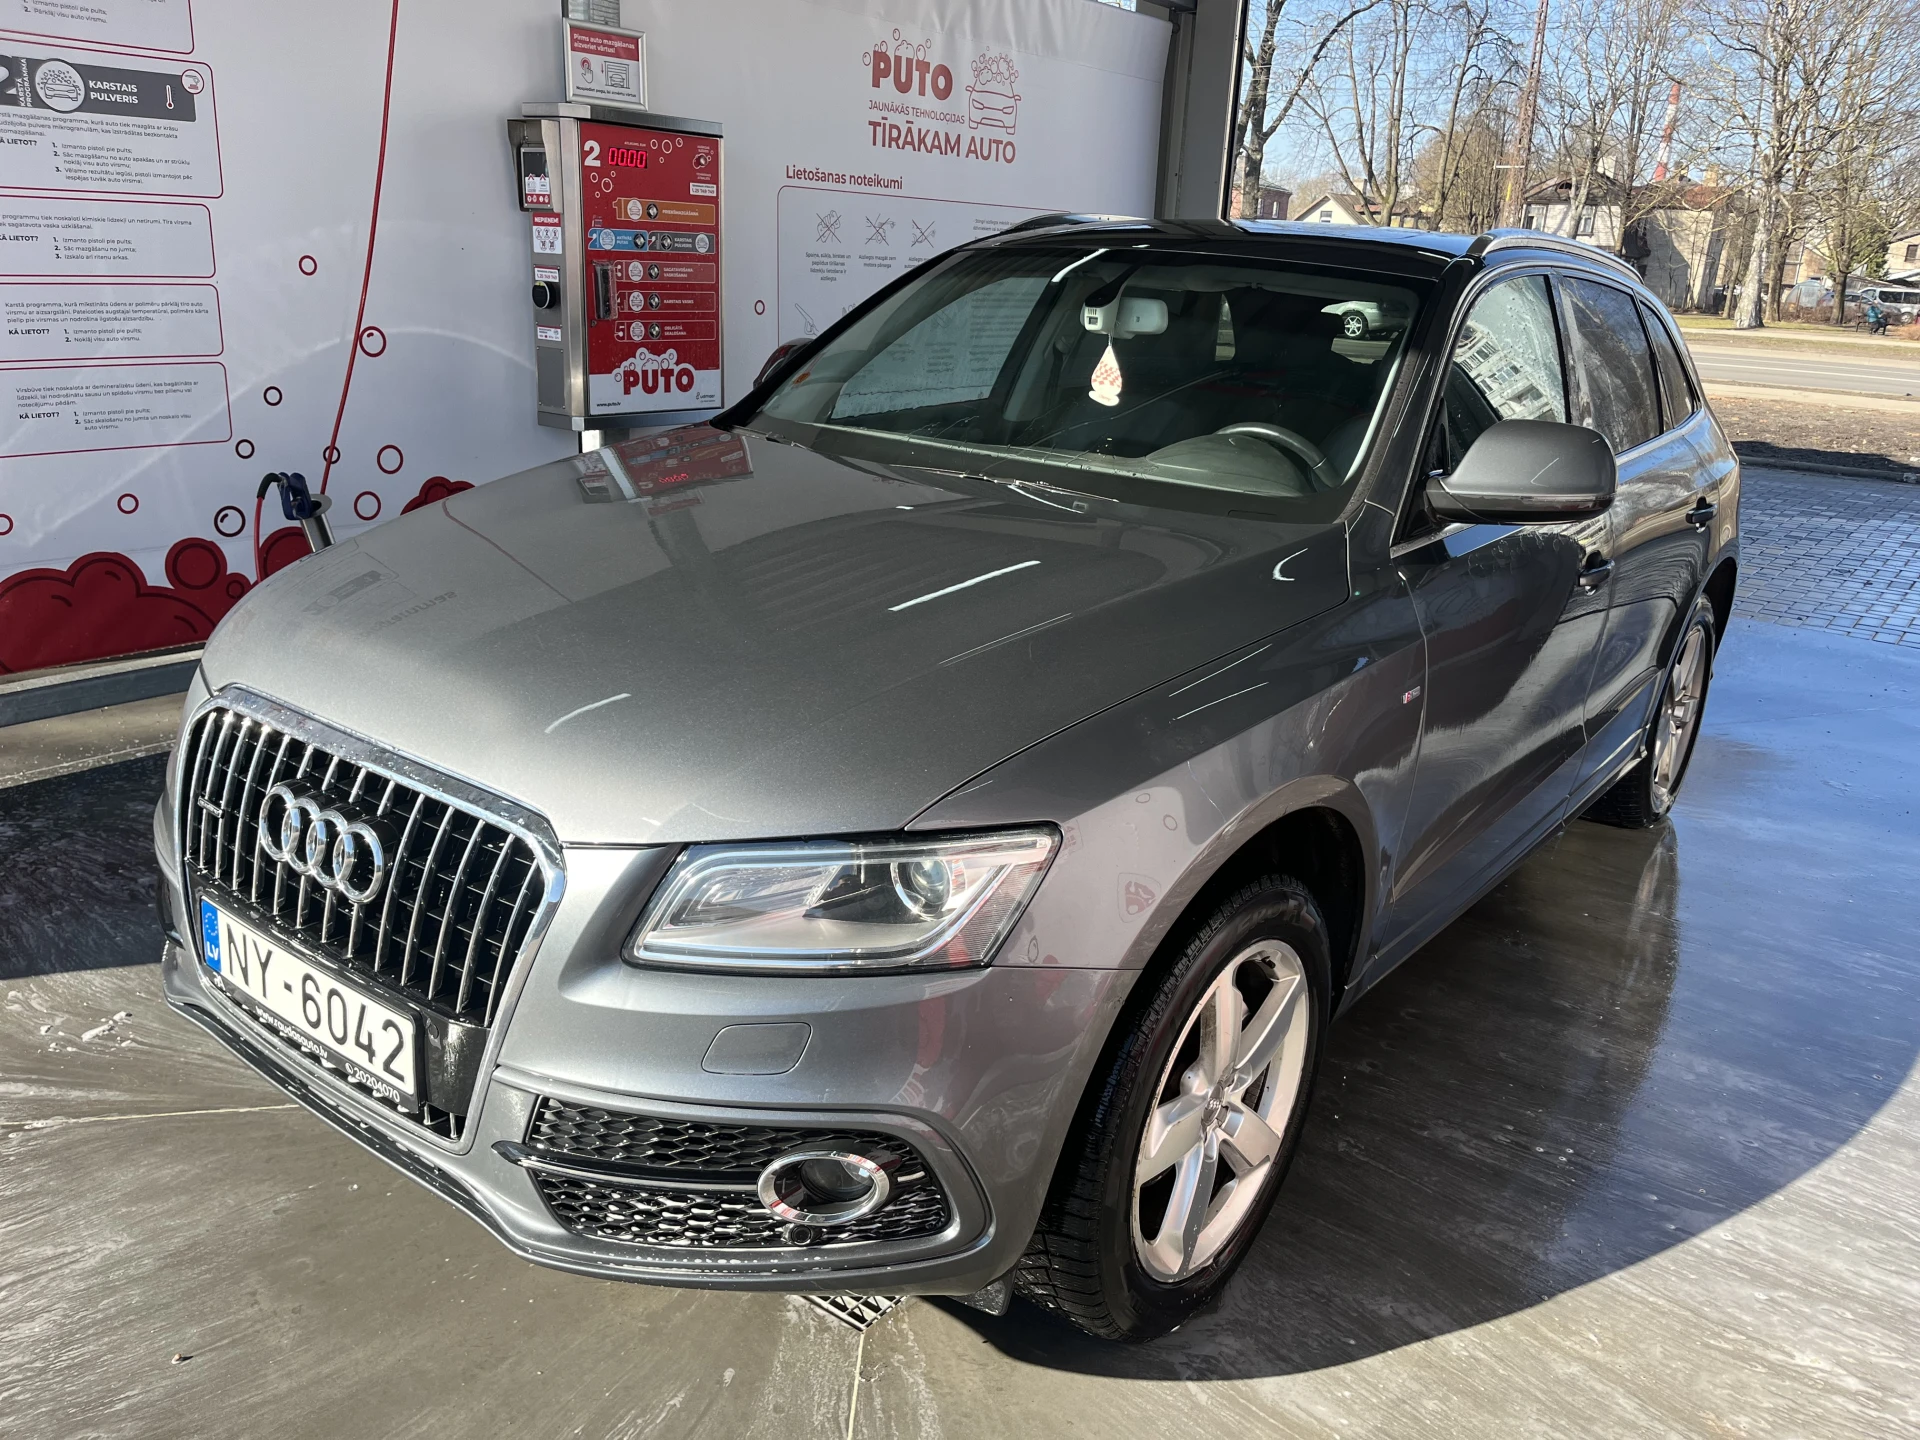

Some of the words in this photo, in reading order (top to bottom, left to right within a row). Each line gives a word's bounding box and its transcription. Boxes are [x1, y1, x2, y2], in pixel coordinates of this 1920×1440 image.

[574, 33, 589, 42] Pirms
[574, 41, 597, 50] aizveriet
[21, 59, 32, 107] PROGRAMMA
[89, 80, 137, 92] KARSTAIS
[872, 50, 954, 100] PUTO
[16, 78, 26, 106] KARSTĀ
[90, 92, 138, 103] PULVERIS
[868, 100, 910, 116] JAUNĀKĀS
[911, 106, 965, 124] TEHNOLOĢIJAS
[868, 116, 961, 157] TĪRĀKAM
[965, 136, 1016, 164] AUTO
[584, 140, 600, 167] 2
[786, 165, 846, 185] Lietošanas
[849, 173, 903, 190] noteikumi
[623, 367, 694, 395] PUTO
[206, 941, 219, 960] LV
[226, 922, 406, 1084] NY-6042
